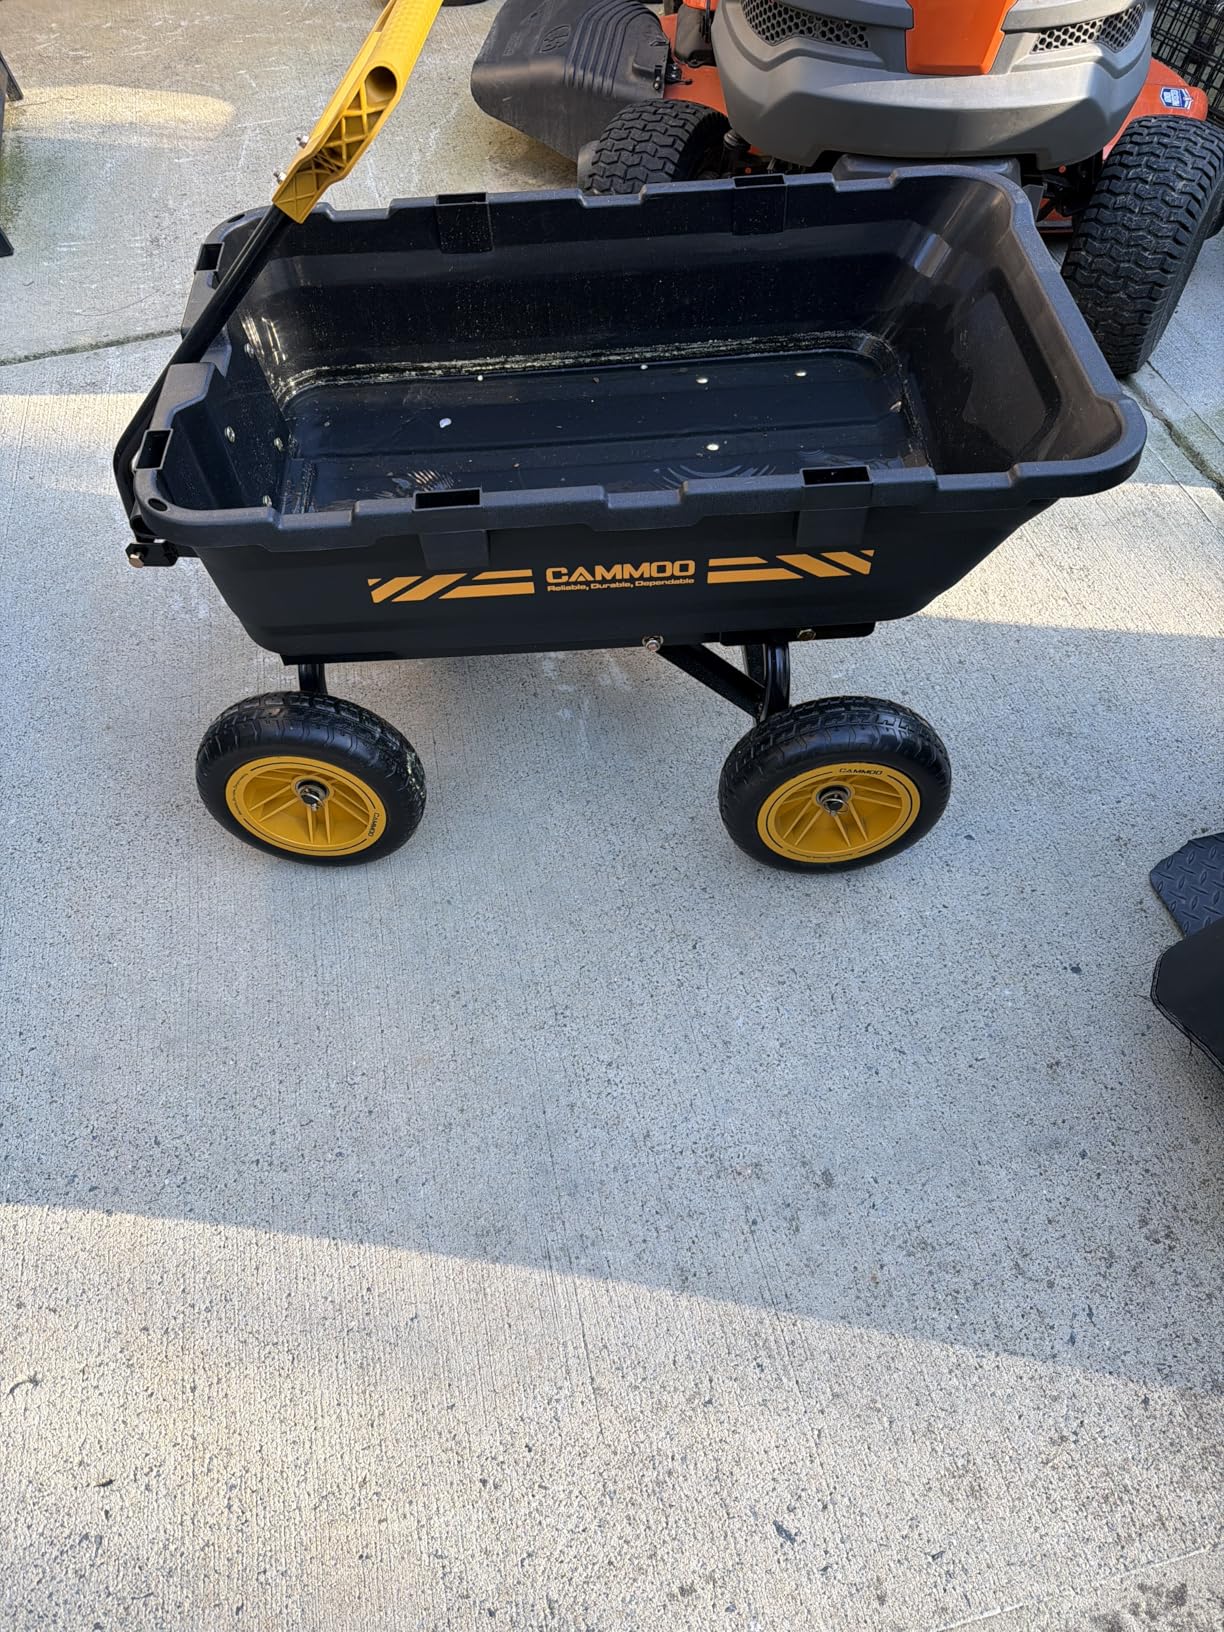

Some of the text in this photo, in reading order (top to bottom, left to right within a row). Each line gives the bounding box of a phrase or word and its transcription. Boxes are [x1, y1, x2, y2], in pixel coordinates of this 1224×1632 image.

[546, 560, 696, 583] CAMMOO
[547, 577, 695, 592] Reliable, Durable, Dependable
